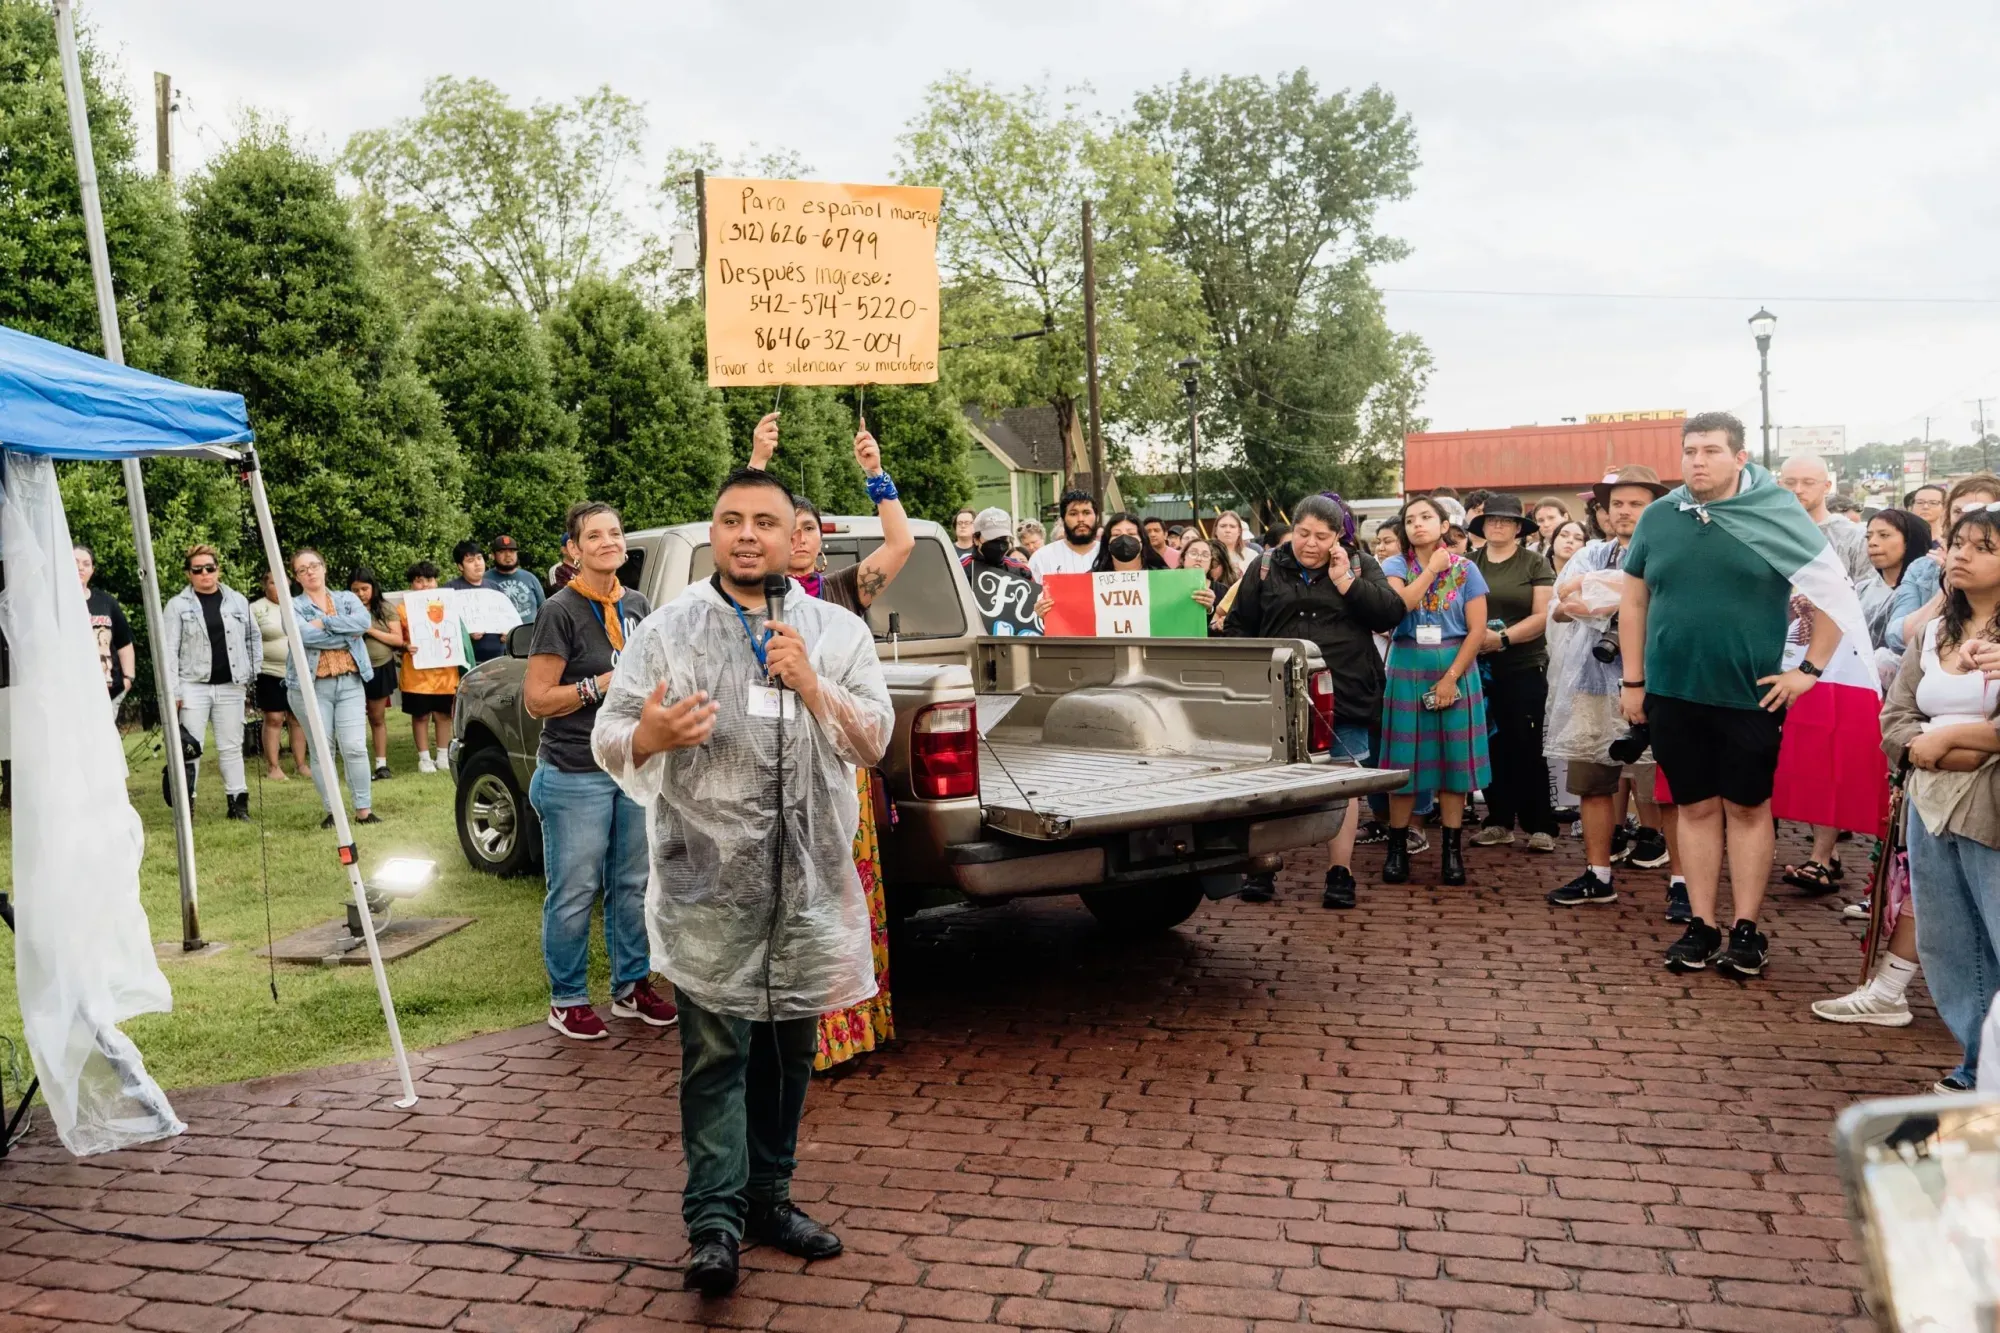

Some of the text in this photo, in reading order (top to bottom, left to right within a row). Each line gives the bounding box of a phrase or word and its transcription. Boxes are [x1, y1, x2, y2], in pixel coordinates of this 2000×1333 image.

[741, 187, 786, 215] Para
[802, 200, 882, 223] español
[719, 258, 806, 291] Después
[754, 327, 902, 358] 8646-32-004
[714, 355, 749, 377] Favor
[757, 358, 774, 375] de
[786, 356, 848, 375] silenciar
[855, 361, 870, 372] su
[1100, 589, 1143, 606] VIVA
[1113, 619, 1133, 634] LA
